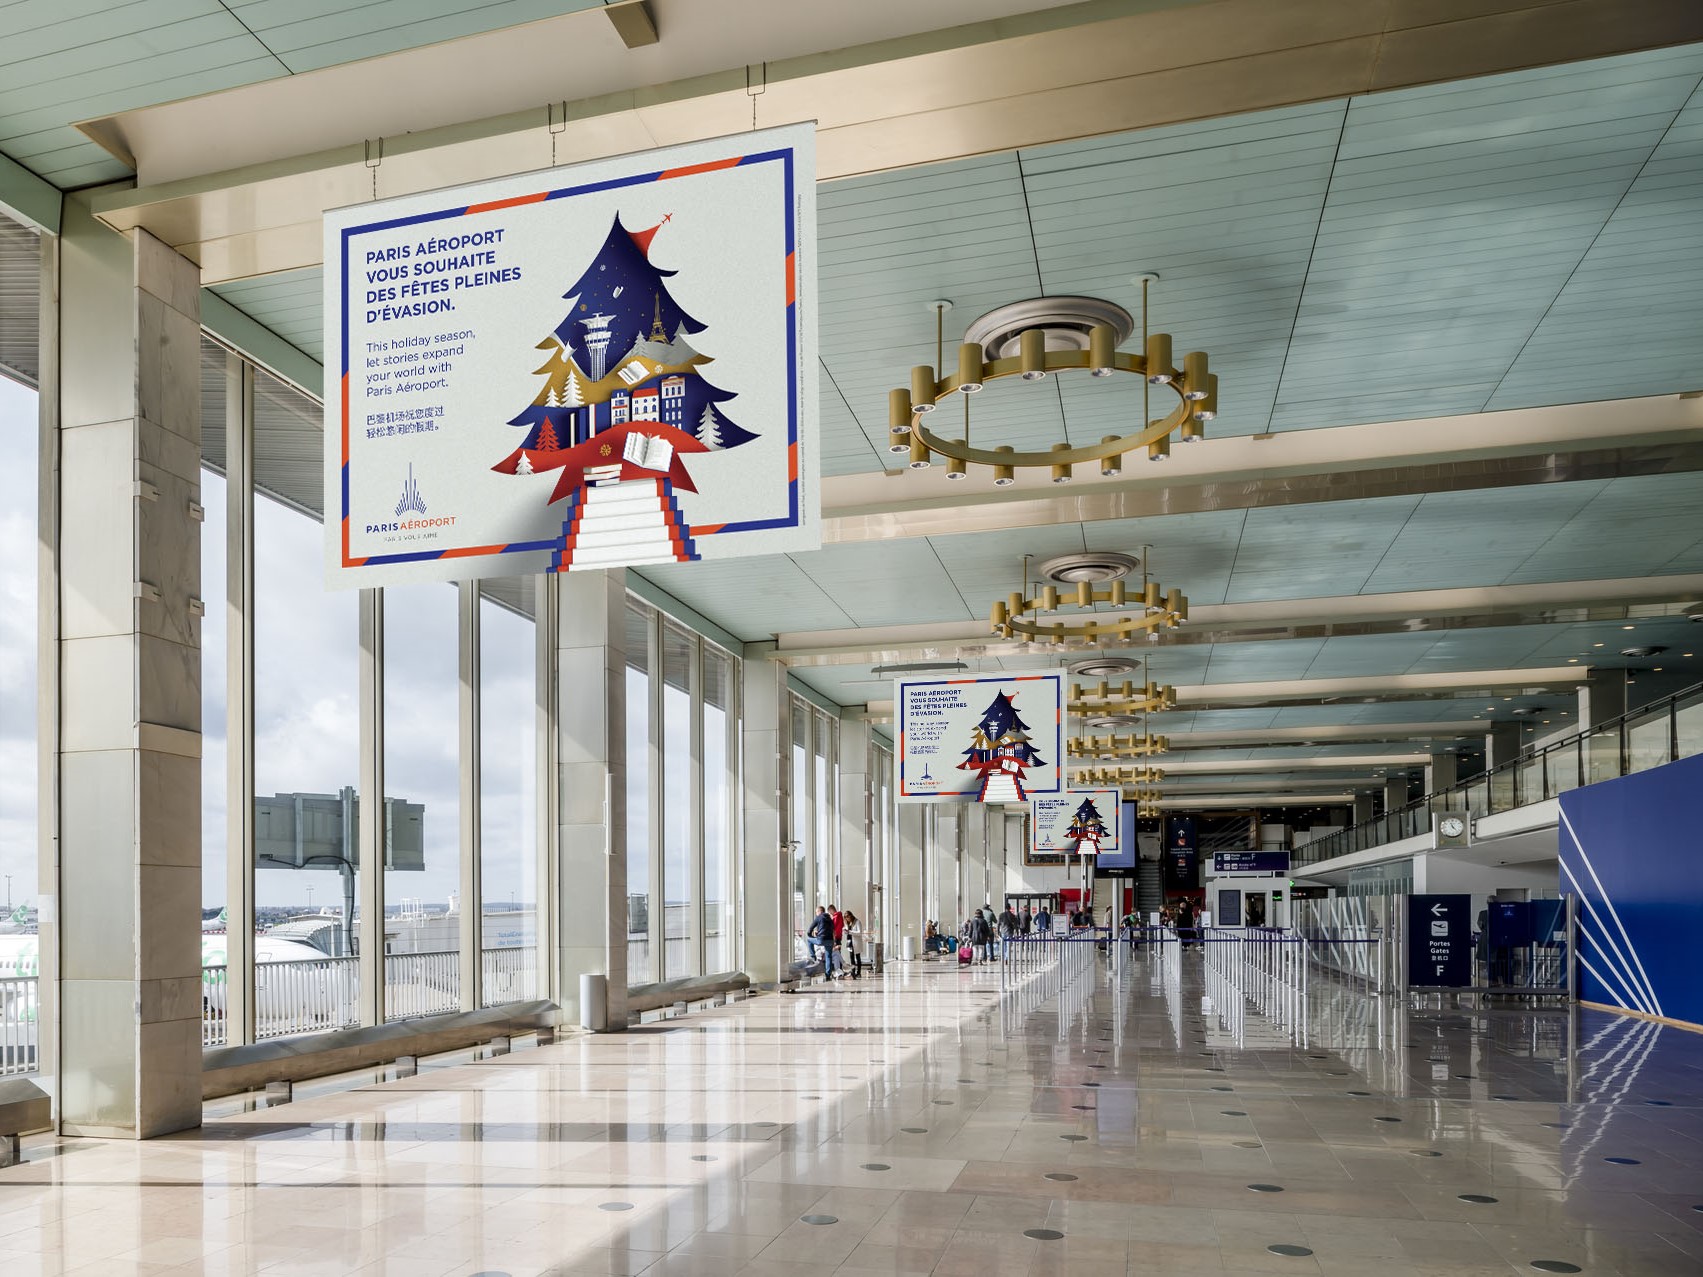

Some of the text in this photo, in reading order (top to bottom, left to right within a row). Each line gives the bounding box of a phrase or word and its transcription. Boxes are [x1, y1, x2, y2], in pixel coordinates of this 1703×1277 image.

[366, 229, 505, 265] PARIS AÉROPORT
[366, 250, 496, 285] VOUS SOUHAITE
[366, 267, 522, 305] DES FÊTES PLEINES
[366, 298, 456, 324] D'ÉVASION.
[366, 330, 476, 353] This holiday season,
[366, 344, 464, 369] let stories expand
[366, 360, 452, 385] your world with
[366, 378, 449, 398] Paris Aéroport.
[366, 516, 457, 534] PARIS AÉROPORT
[1436, 965, 1444, 977] F
